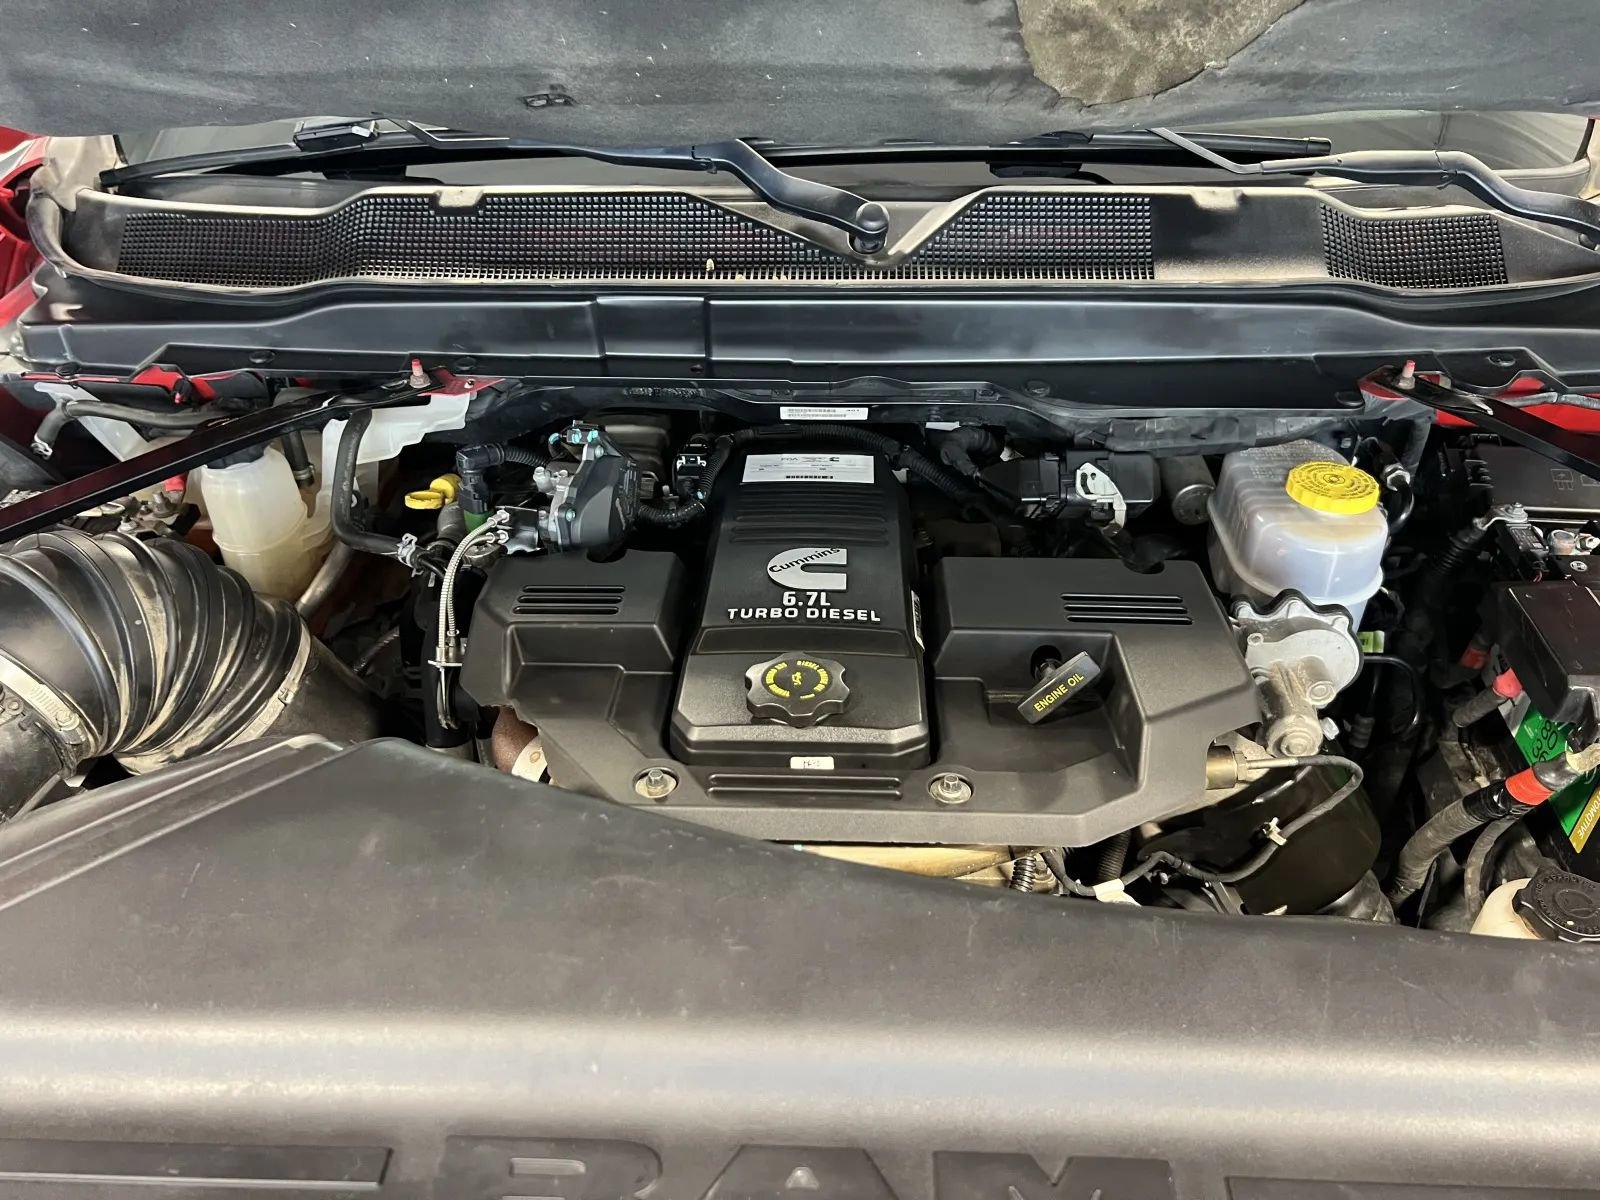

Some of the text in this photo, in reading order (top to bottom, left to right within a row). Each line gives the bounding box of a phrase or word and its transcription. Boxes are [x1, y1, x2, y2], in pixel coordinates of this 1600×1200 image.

[769, 547, 841, 573] Cummins
[782, 591, 831, 607] 6.7L
[727, 607, 881, 622] TURBO DIESEL
[1034, 673, 1084, 712] ENGINE OIL
